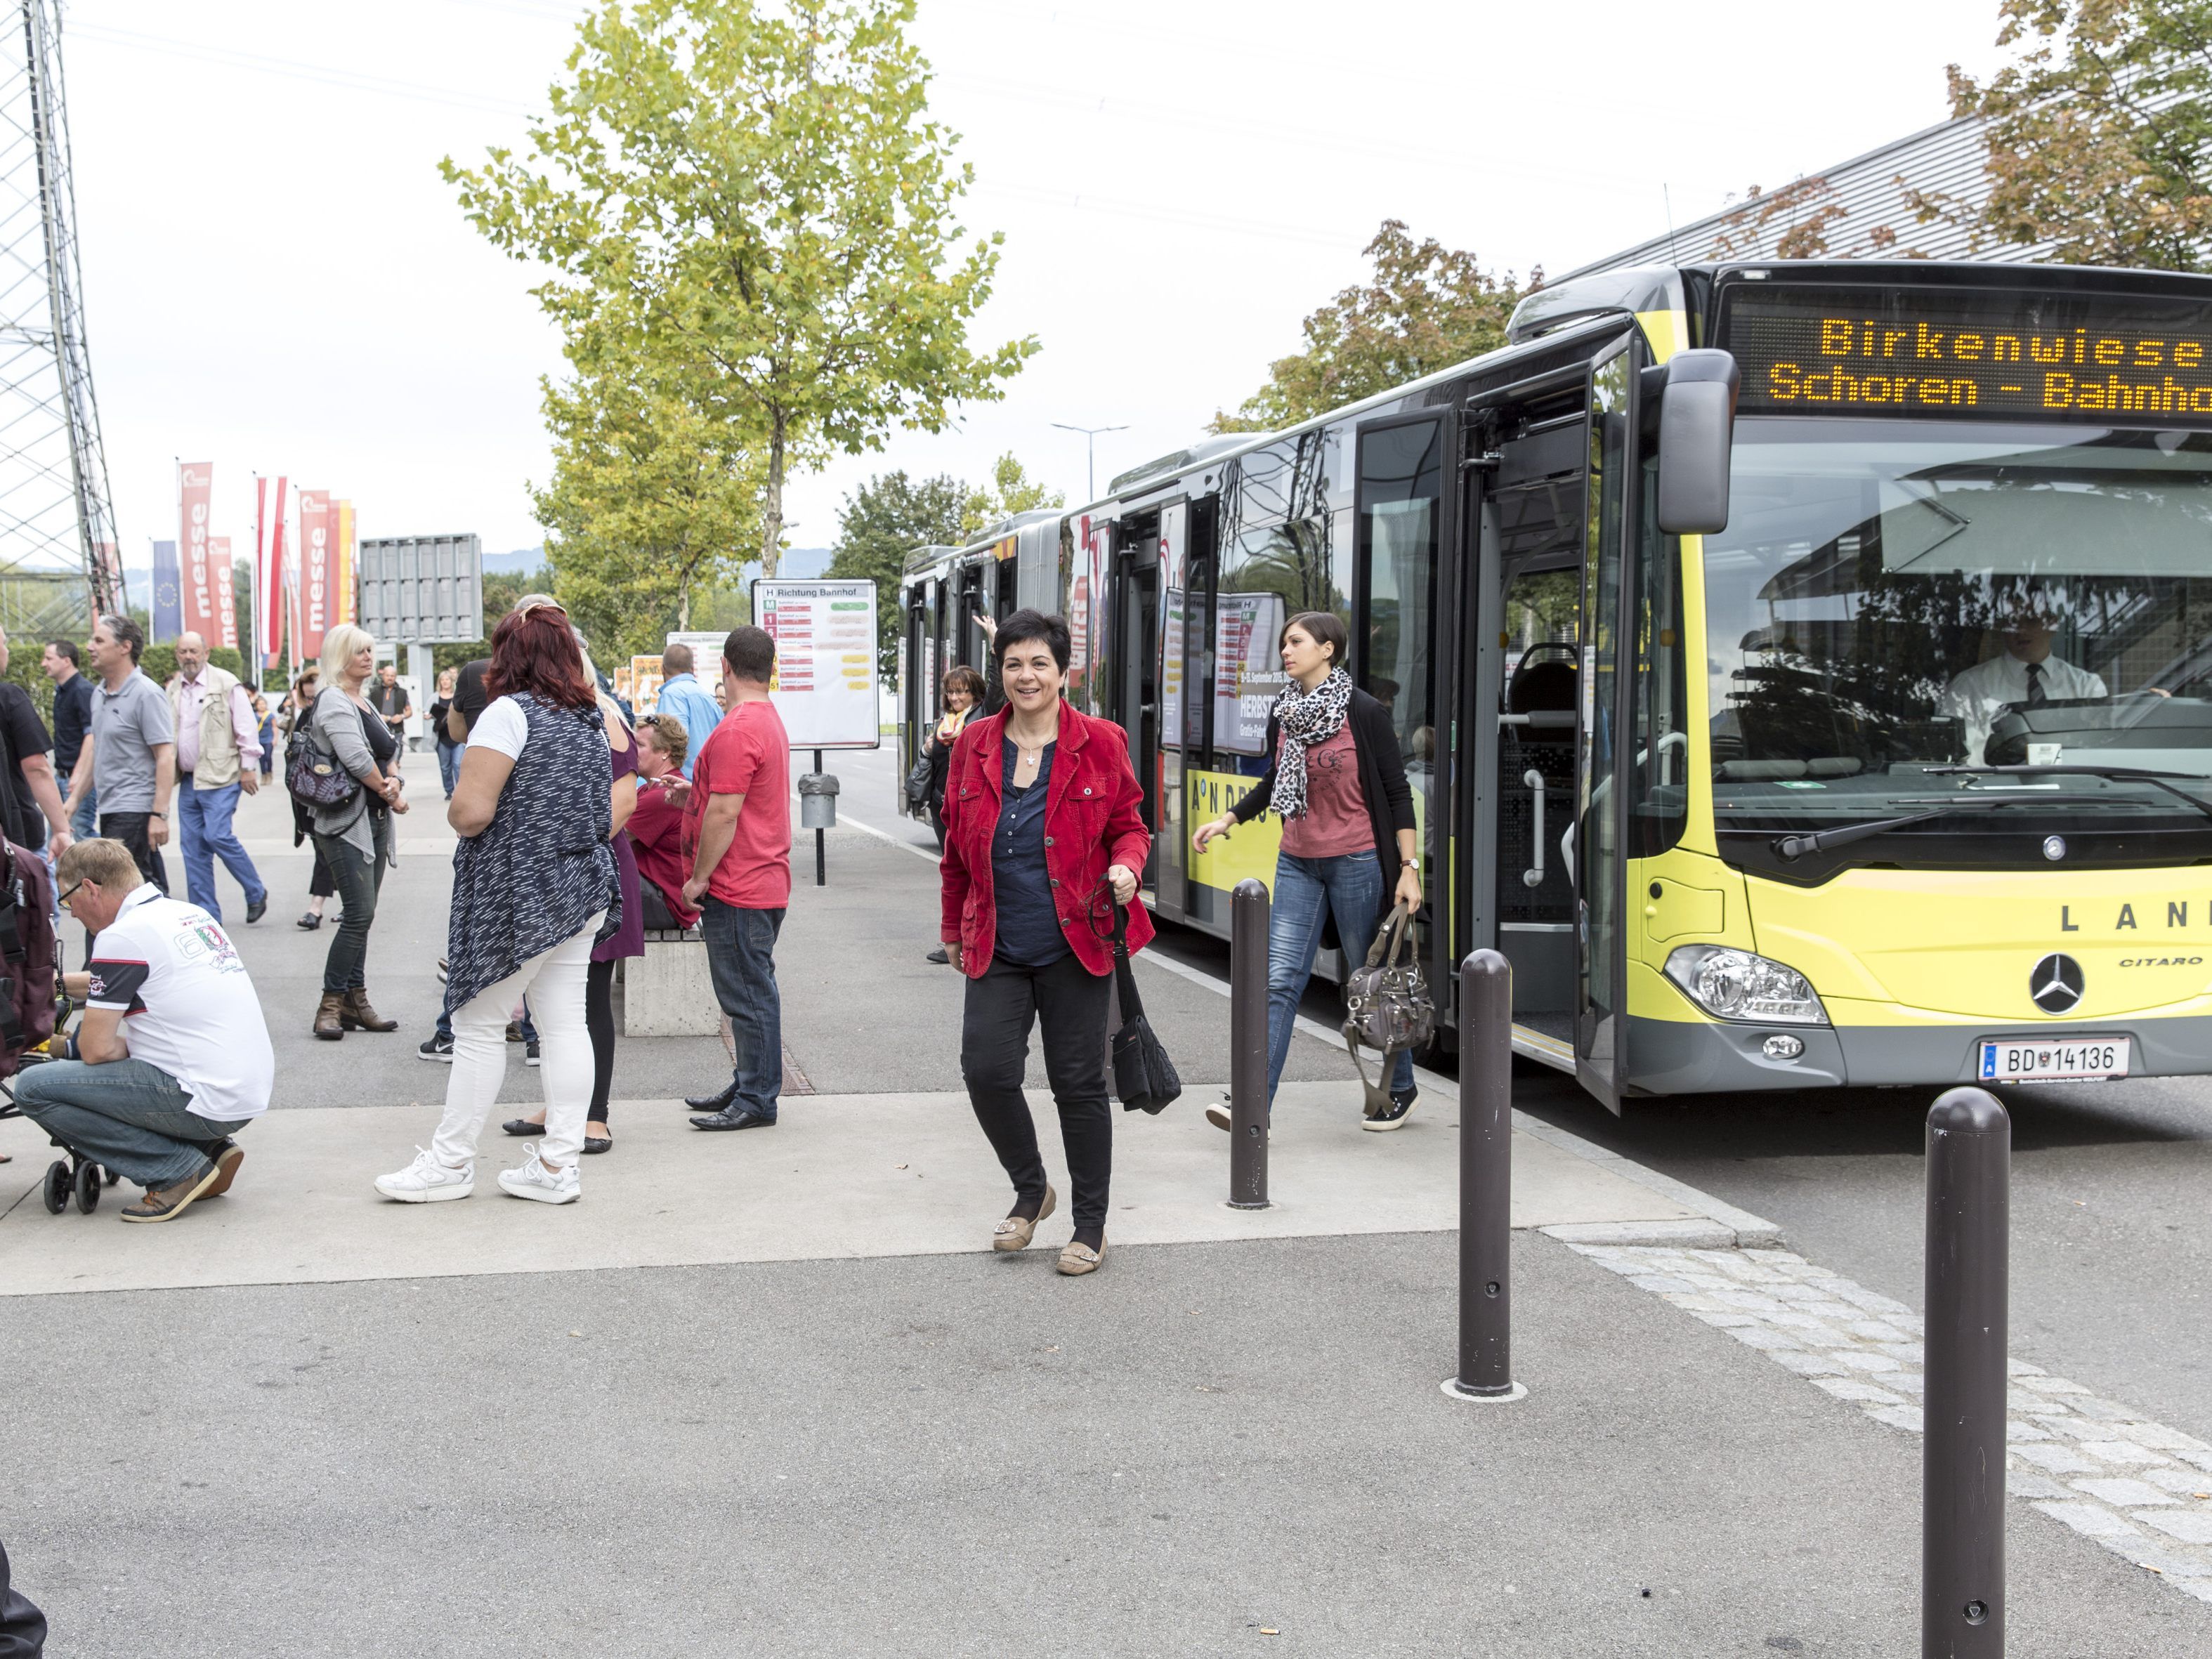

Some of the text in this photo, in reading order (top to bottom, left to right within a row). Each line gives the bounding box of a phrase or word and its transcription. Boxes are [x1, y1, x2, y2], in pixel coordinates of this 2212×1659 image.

[1821, 319, 2204, 368] Birkenwiese
[1769, 362, 1977, 405] Schoren
[191, 502, 211, 618] messe
[310, 527, 327, 632] messe
[766, 601, 775, 609] M
[778, 589, 817, 598] Richtung
[768, 615, 773, 624] 1
[1251, 671, 1272, 685] September
[1240, 694, 1276, 719] HERBST
[2062, 900, 2212, 932] LAN
[2119, 957, 2204, 967] CITARO
[1985, 1065, 1993, 1073] A
[2008, 1047, 2114, 1072] BD 14136
